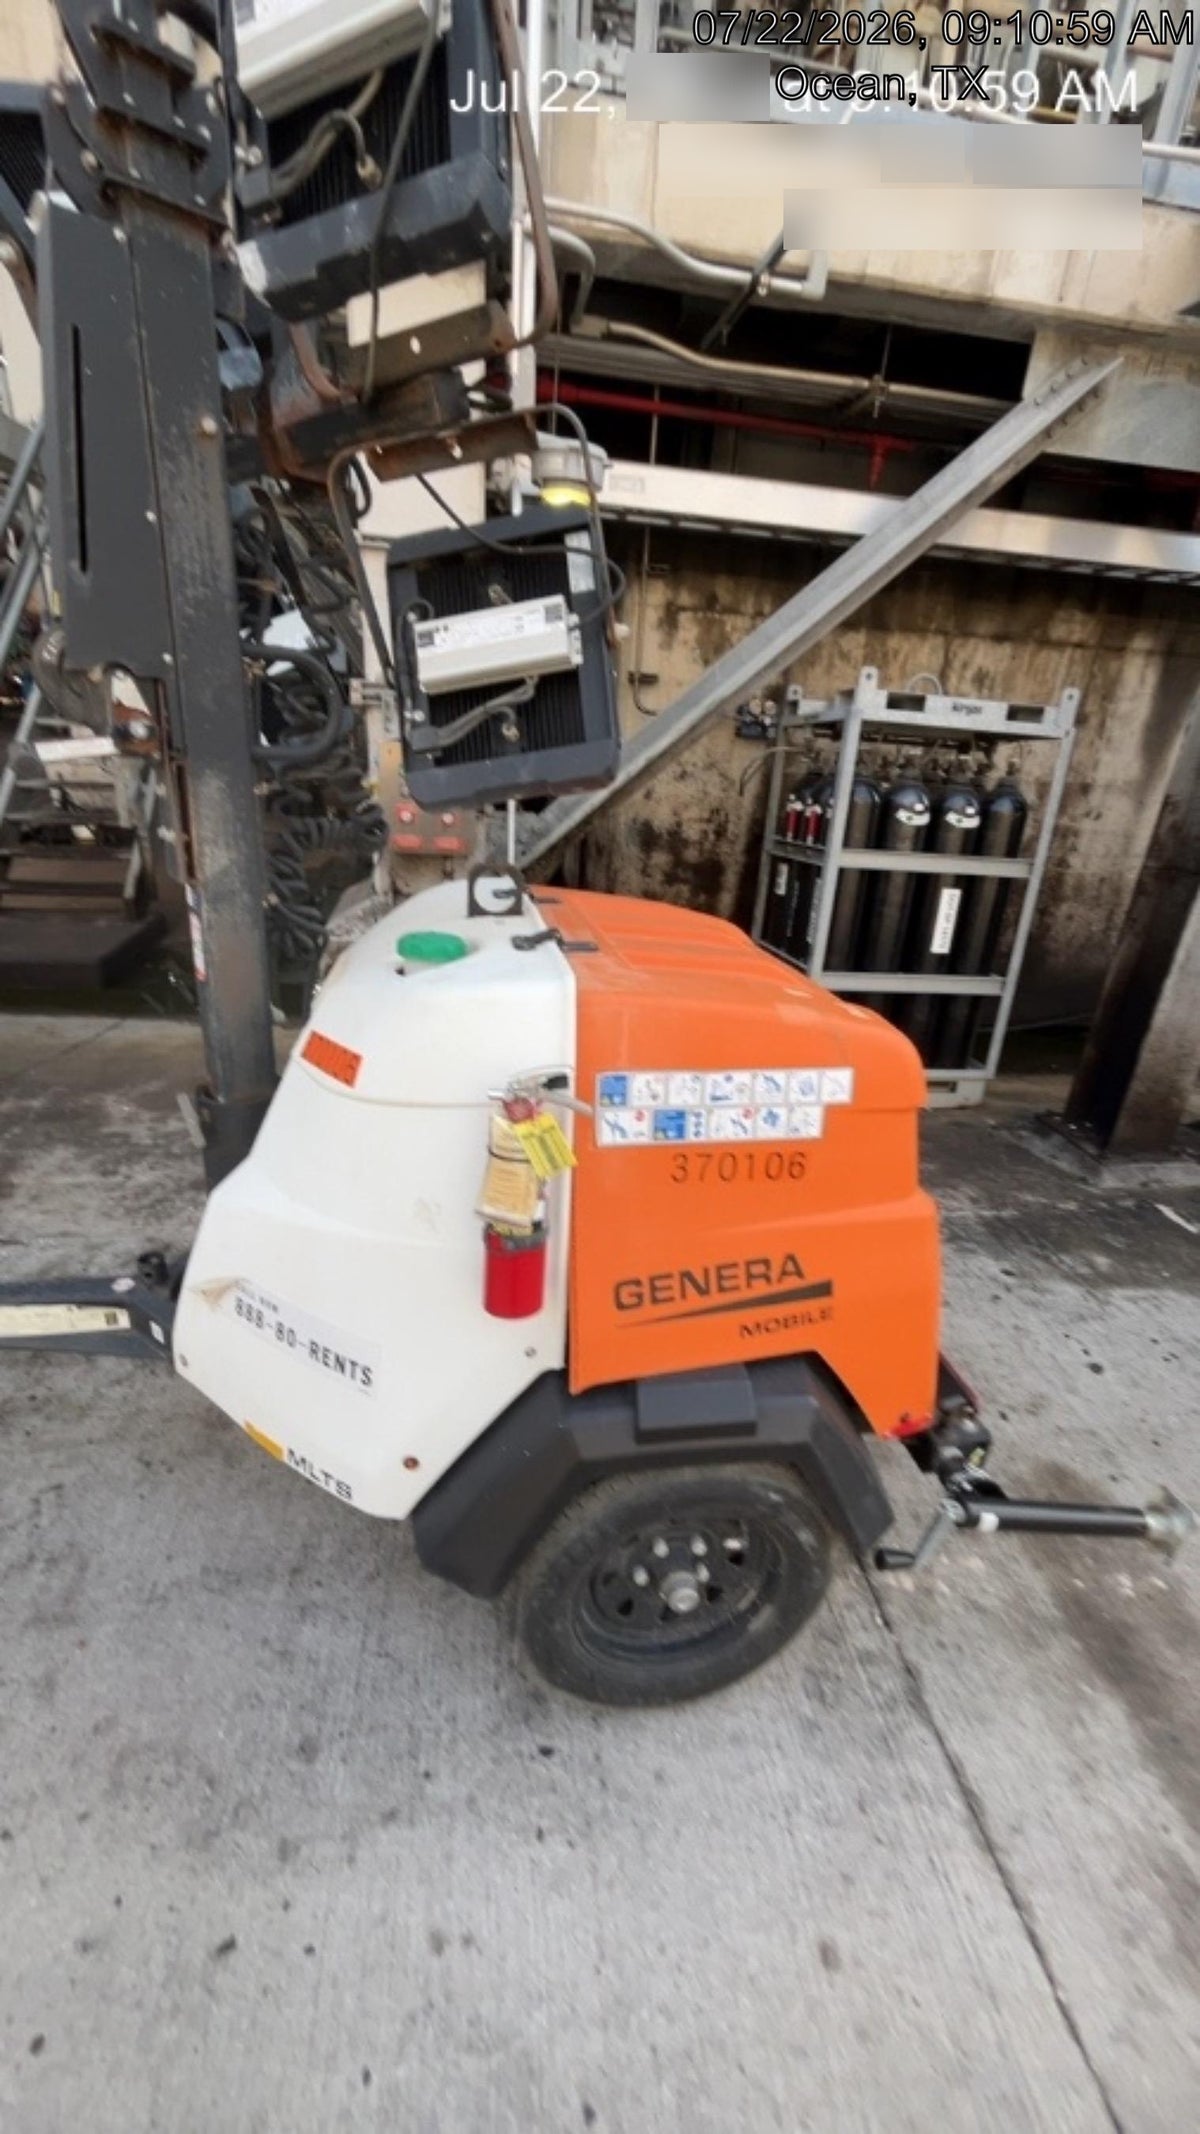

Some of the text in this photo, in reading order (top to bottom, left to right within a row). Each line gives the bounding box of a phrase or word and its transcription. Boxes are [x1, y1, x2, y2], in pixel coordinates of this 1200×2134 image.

[669, 1151, 807, 1183] 370106
[613, 1253, 805, 1312] GENERA
[234, 1296, 374, 1388] 888-80-RENTS
[739, 1305, 834, 1338] MOBILE
